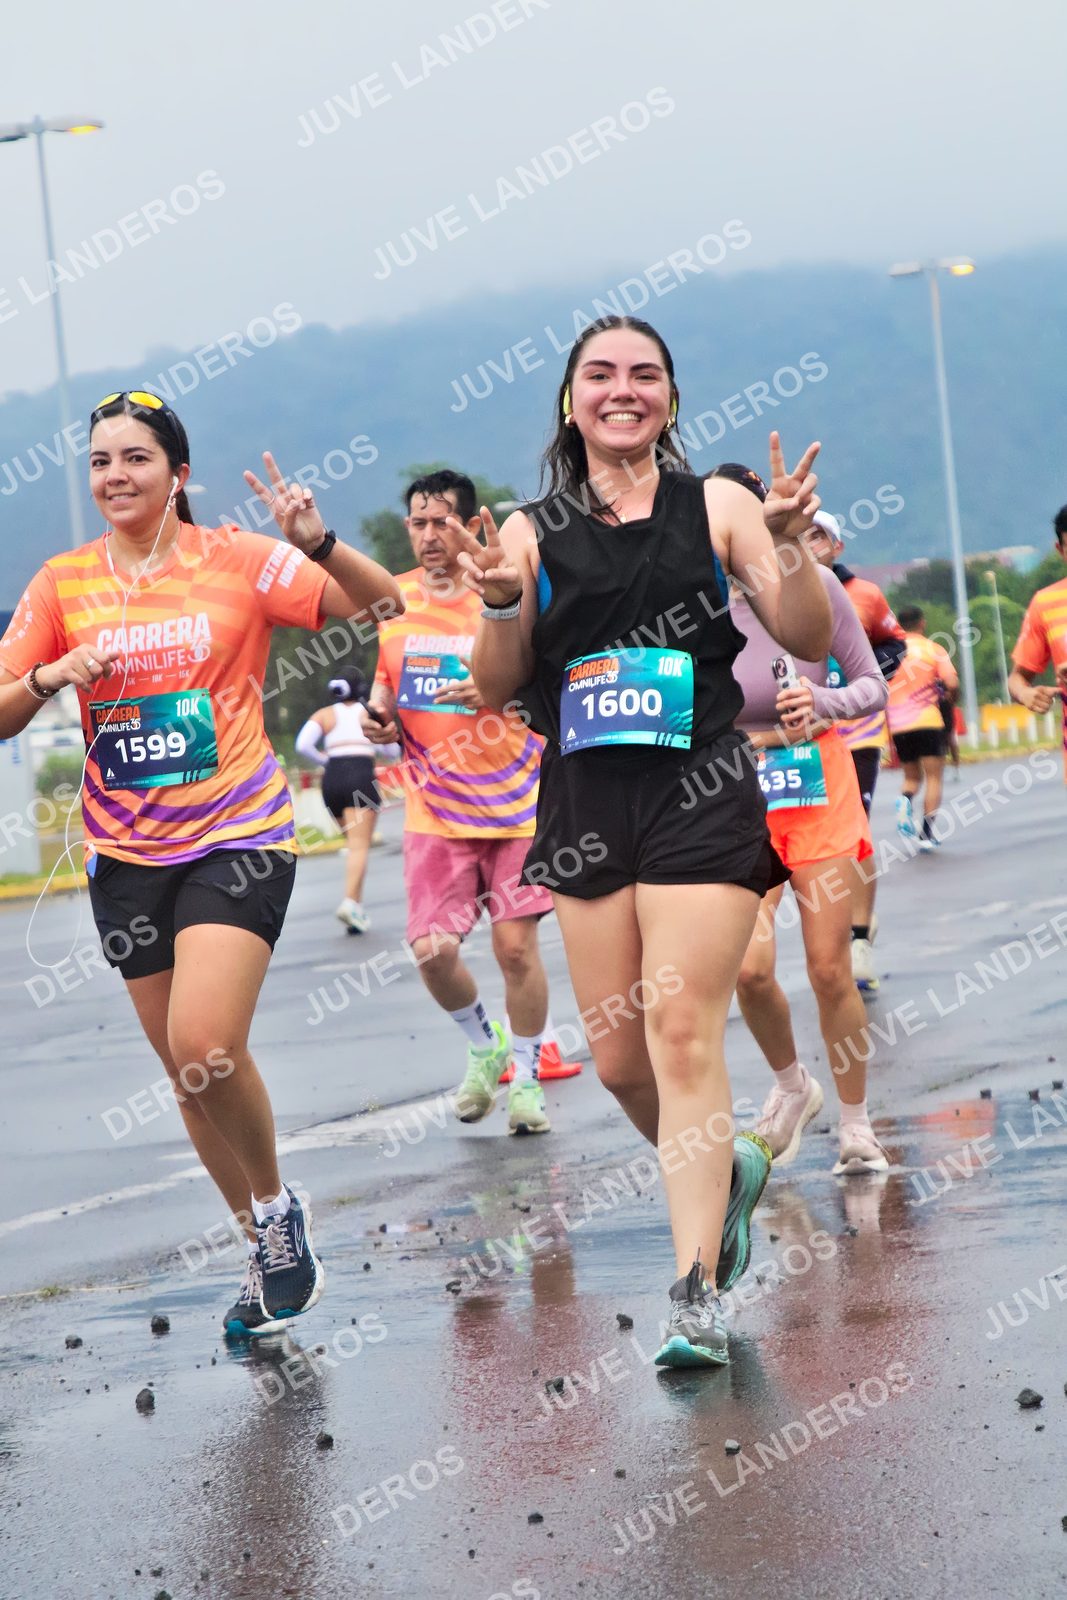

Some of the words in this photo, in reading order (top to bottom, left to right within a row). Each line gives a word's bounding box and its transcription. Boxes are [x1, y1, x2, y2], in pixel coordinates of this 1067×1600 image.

[97, 612, 210, 655] CARRERA
[404, 634, 475, 654] CARRERA
[569, 657, 619, 682] CARRERA
[657, 656, 684, 678] 10K
[568, 674, 606, 692] OMNILIFE
[96, 705, 141, 723] CARRERA
[176, 697, 200, 717] 10K
[581, 688, 663, 720] 1600
[98, 721, 131, 733] OMNILIFE
[115, 732, 187, 763] 1599
[793, 746, 812, 760] 10K
